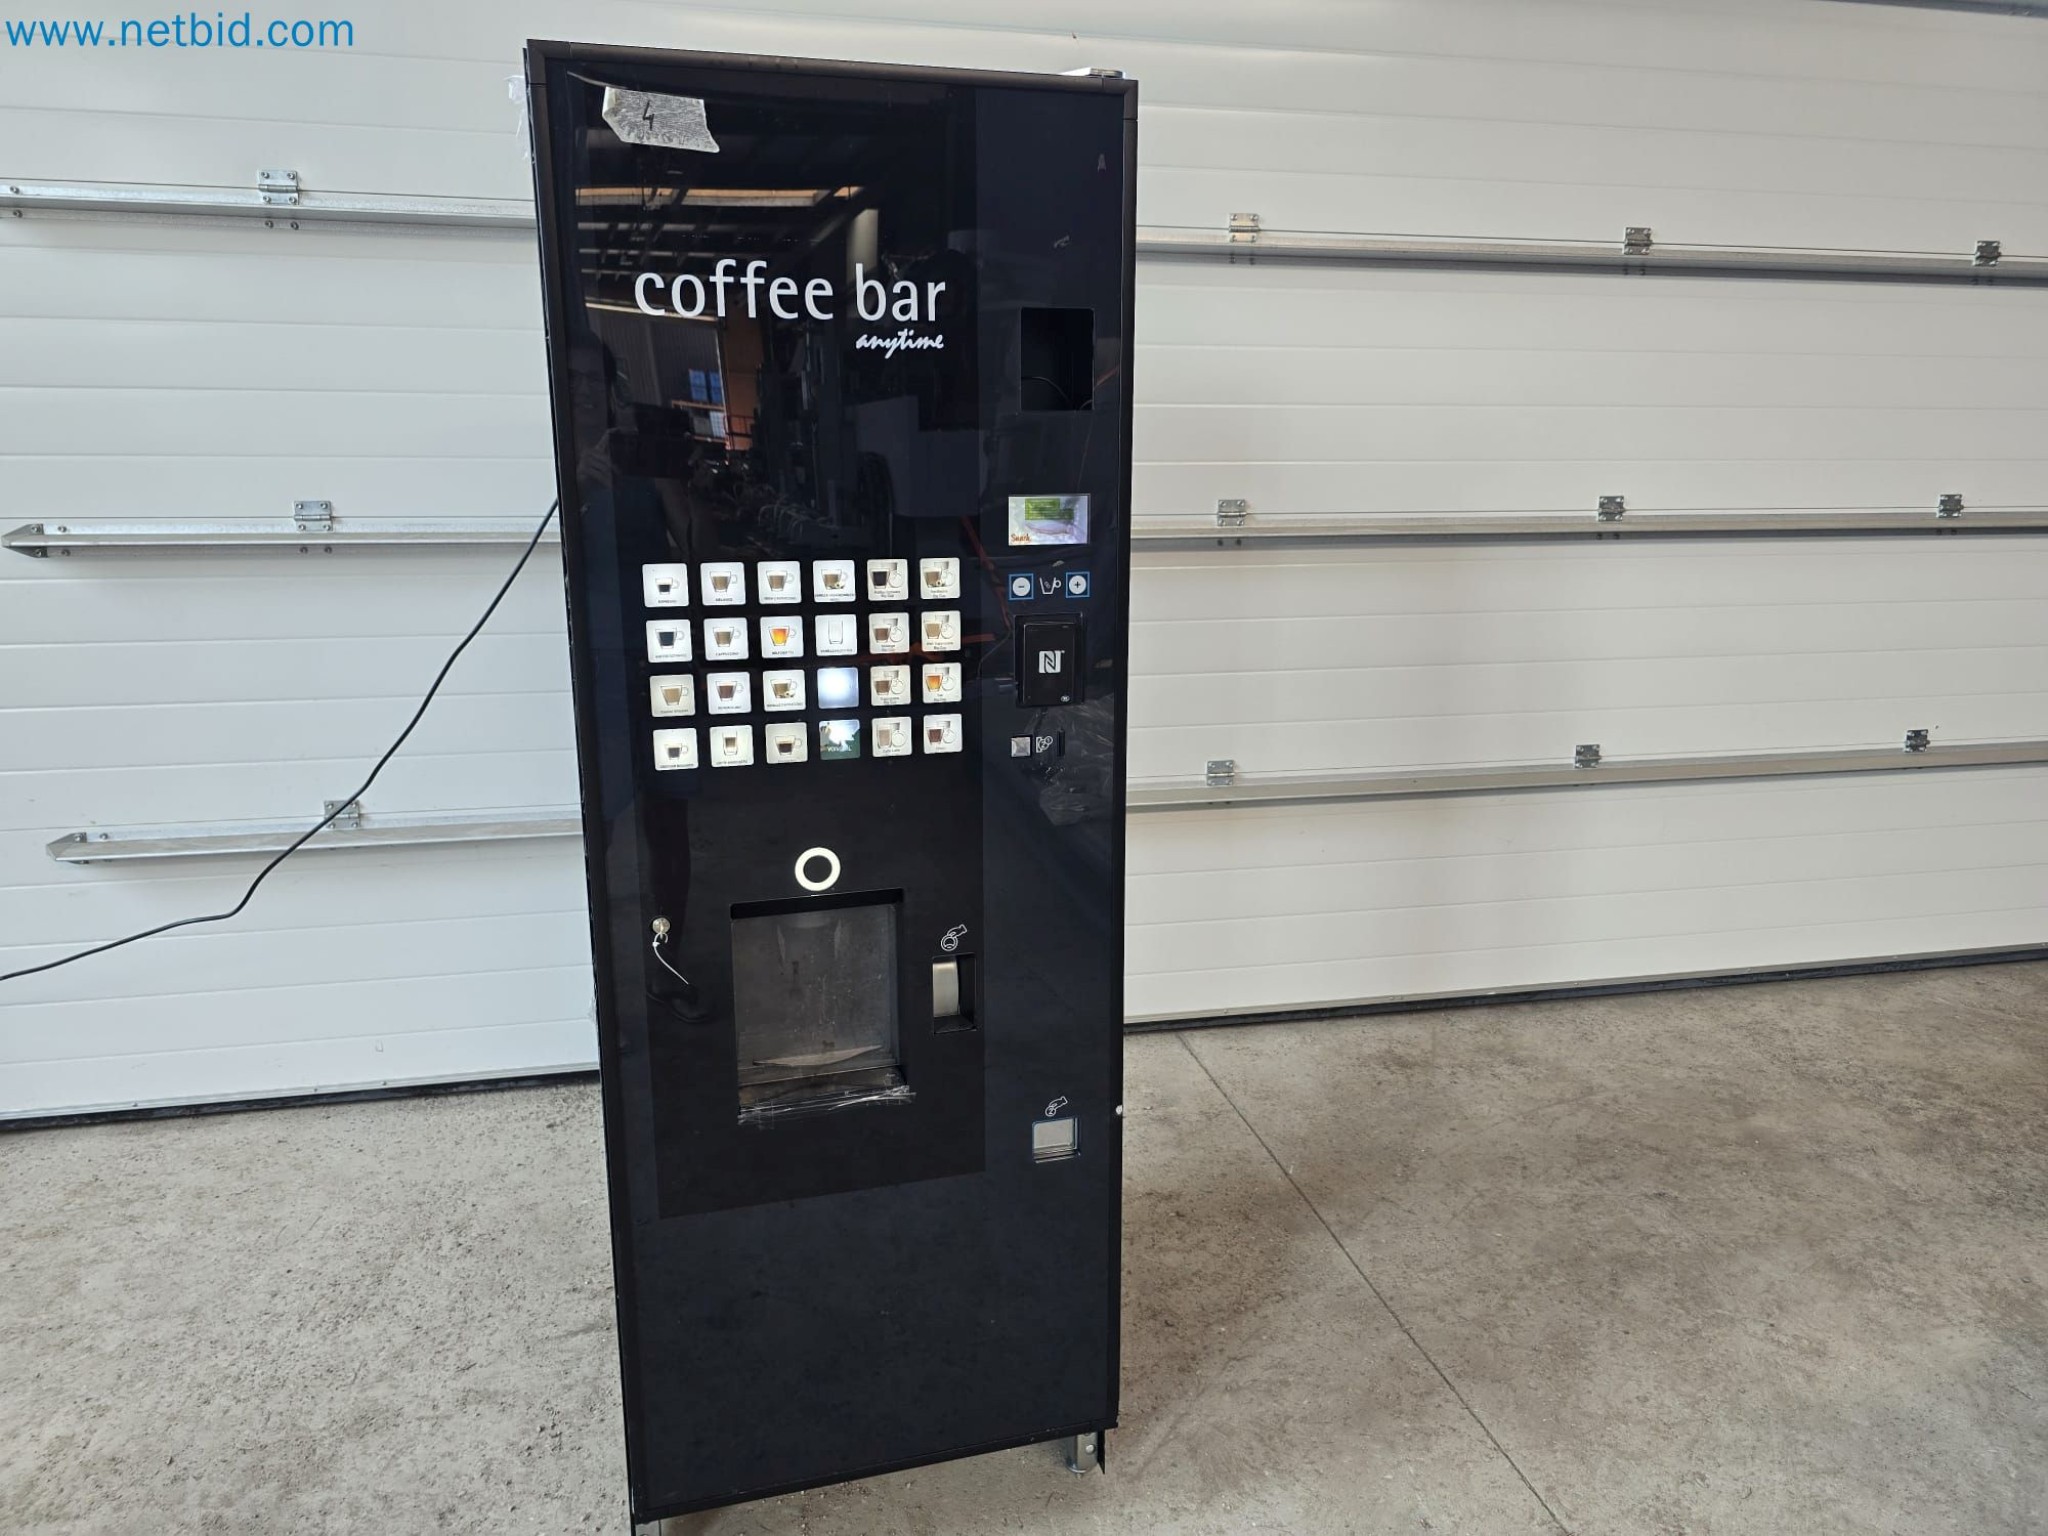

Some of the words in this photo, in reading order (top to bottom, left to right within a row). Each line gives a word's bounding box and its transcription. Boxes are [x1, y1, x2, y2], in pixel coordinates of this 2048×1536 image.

[642, 100, 655, 131] 4
[634, 258, 834, 320] coffee
[855, 262, 946, 322] bar
[855, 328, 945, 359] anytime
